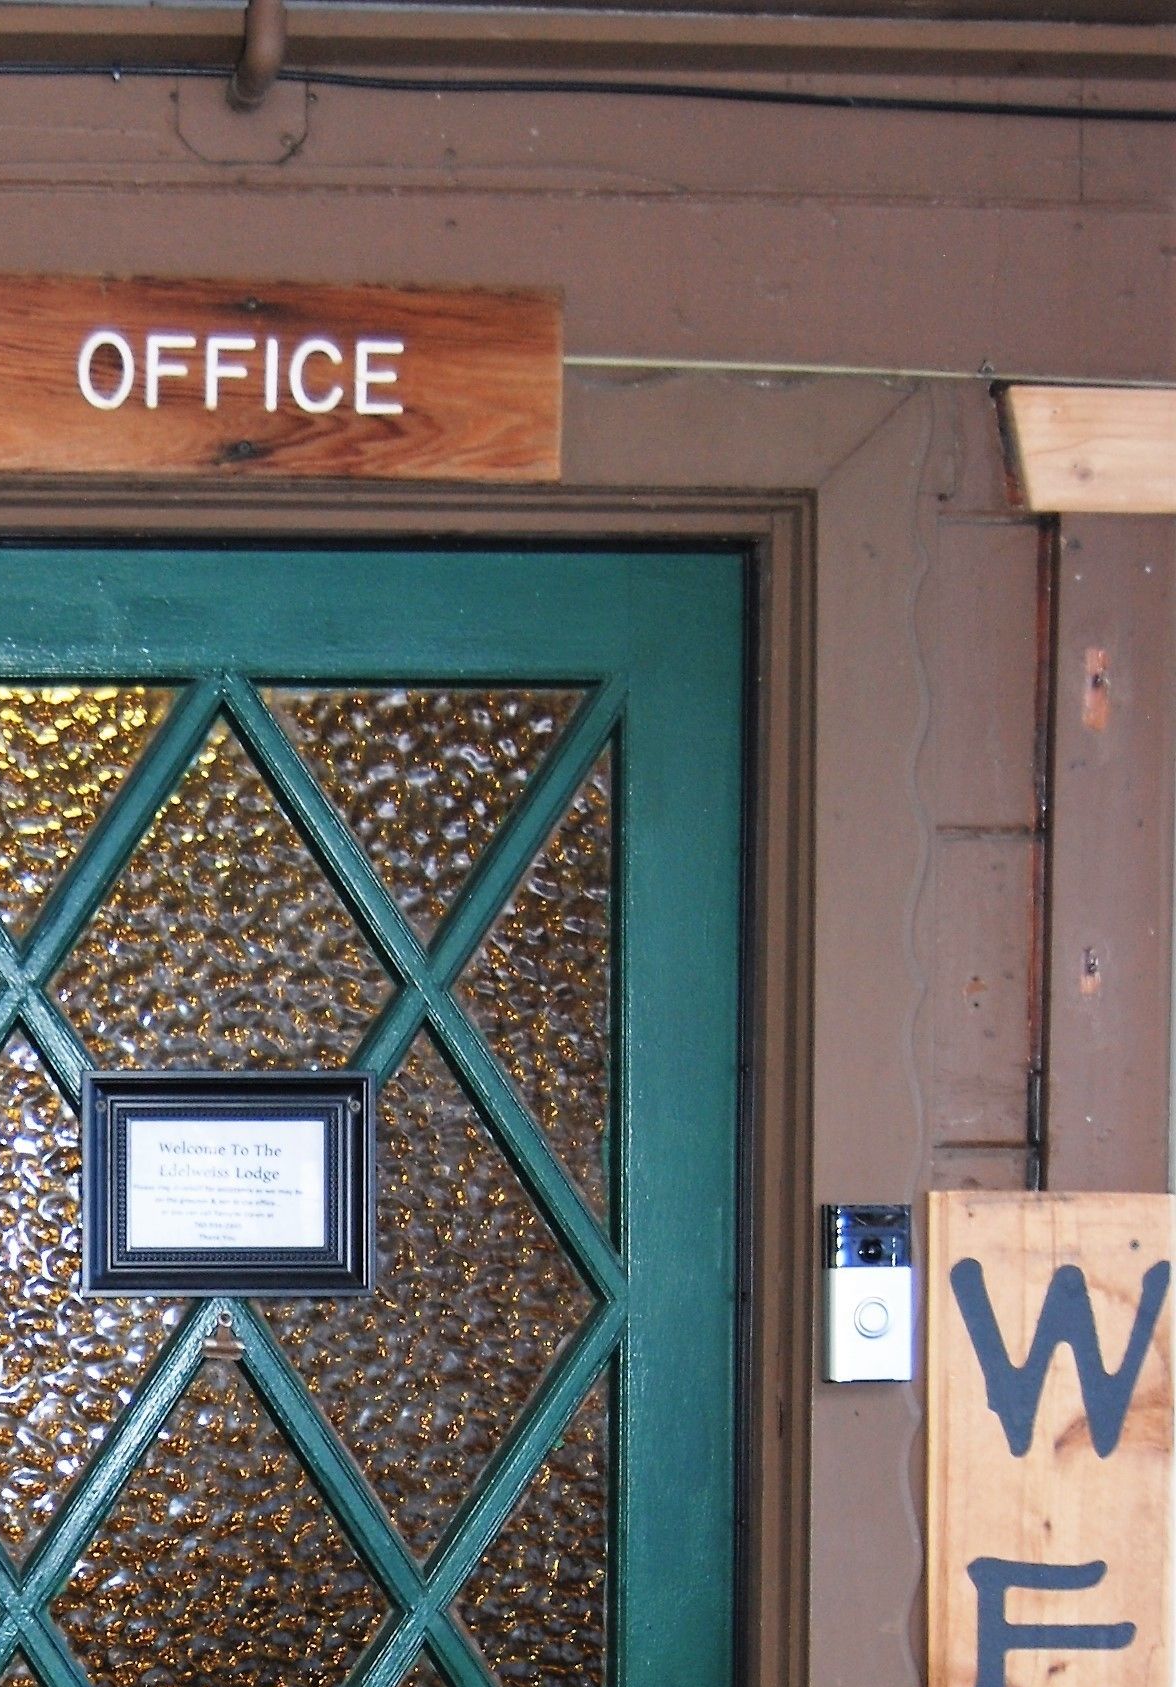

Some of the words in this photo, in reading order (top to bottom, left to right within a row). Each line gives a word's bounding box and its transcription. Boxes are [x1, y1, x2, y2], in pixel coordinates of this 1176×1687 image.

[77, 330, 404, 415] OFFICE
[159, 1141, 226, 1156] Welcome
[231, 1143, 249, 1157] To
[254, 1143, 282, 1158] The
[236, 1165, 280, 1183] Lodge
